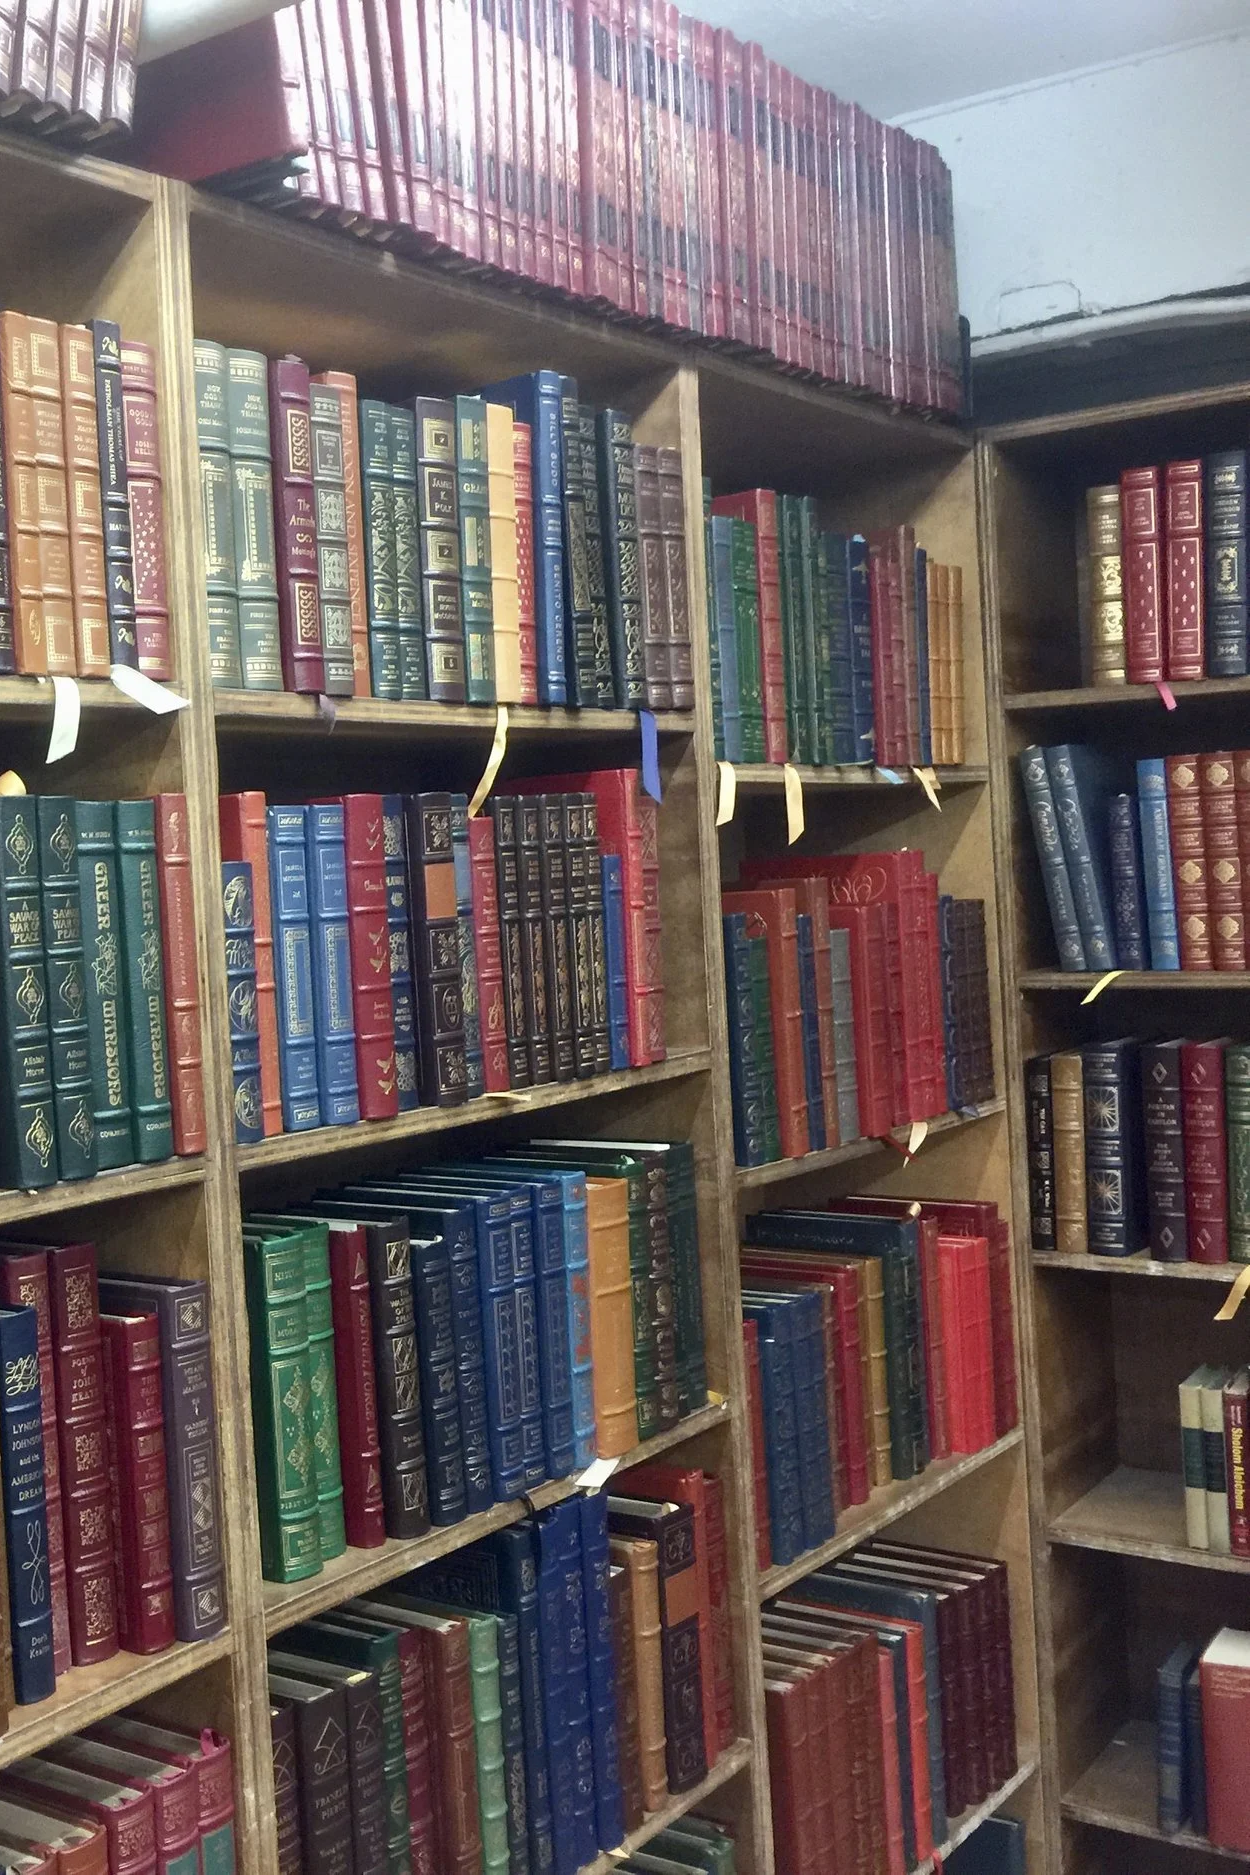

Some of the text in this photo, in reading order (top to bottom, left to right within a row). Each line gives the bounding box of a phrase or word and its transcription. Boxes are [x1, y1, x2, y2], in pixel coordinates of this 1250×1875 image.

[22, 901, 29, 911] A
[10, 923, 30, 933] WAR
[18, 1487, 43, 1502] DREAM
